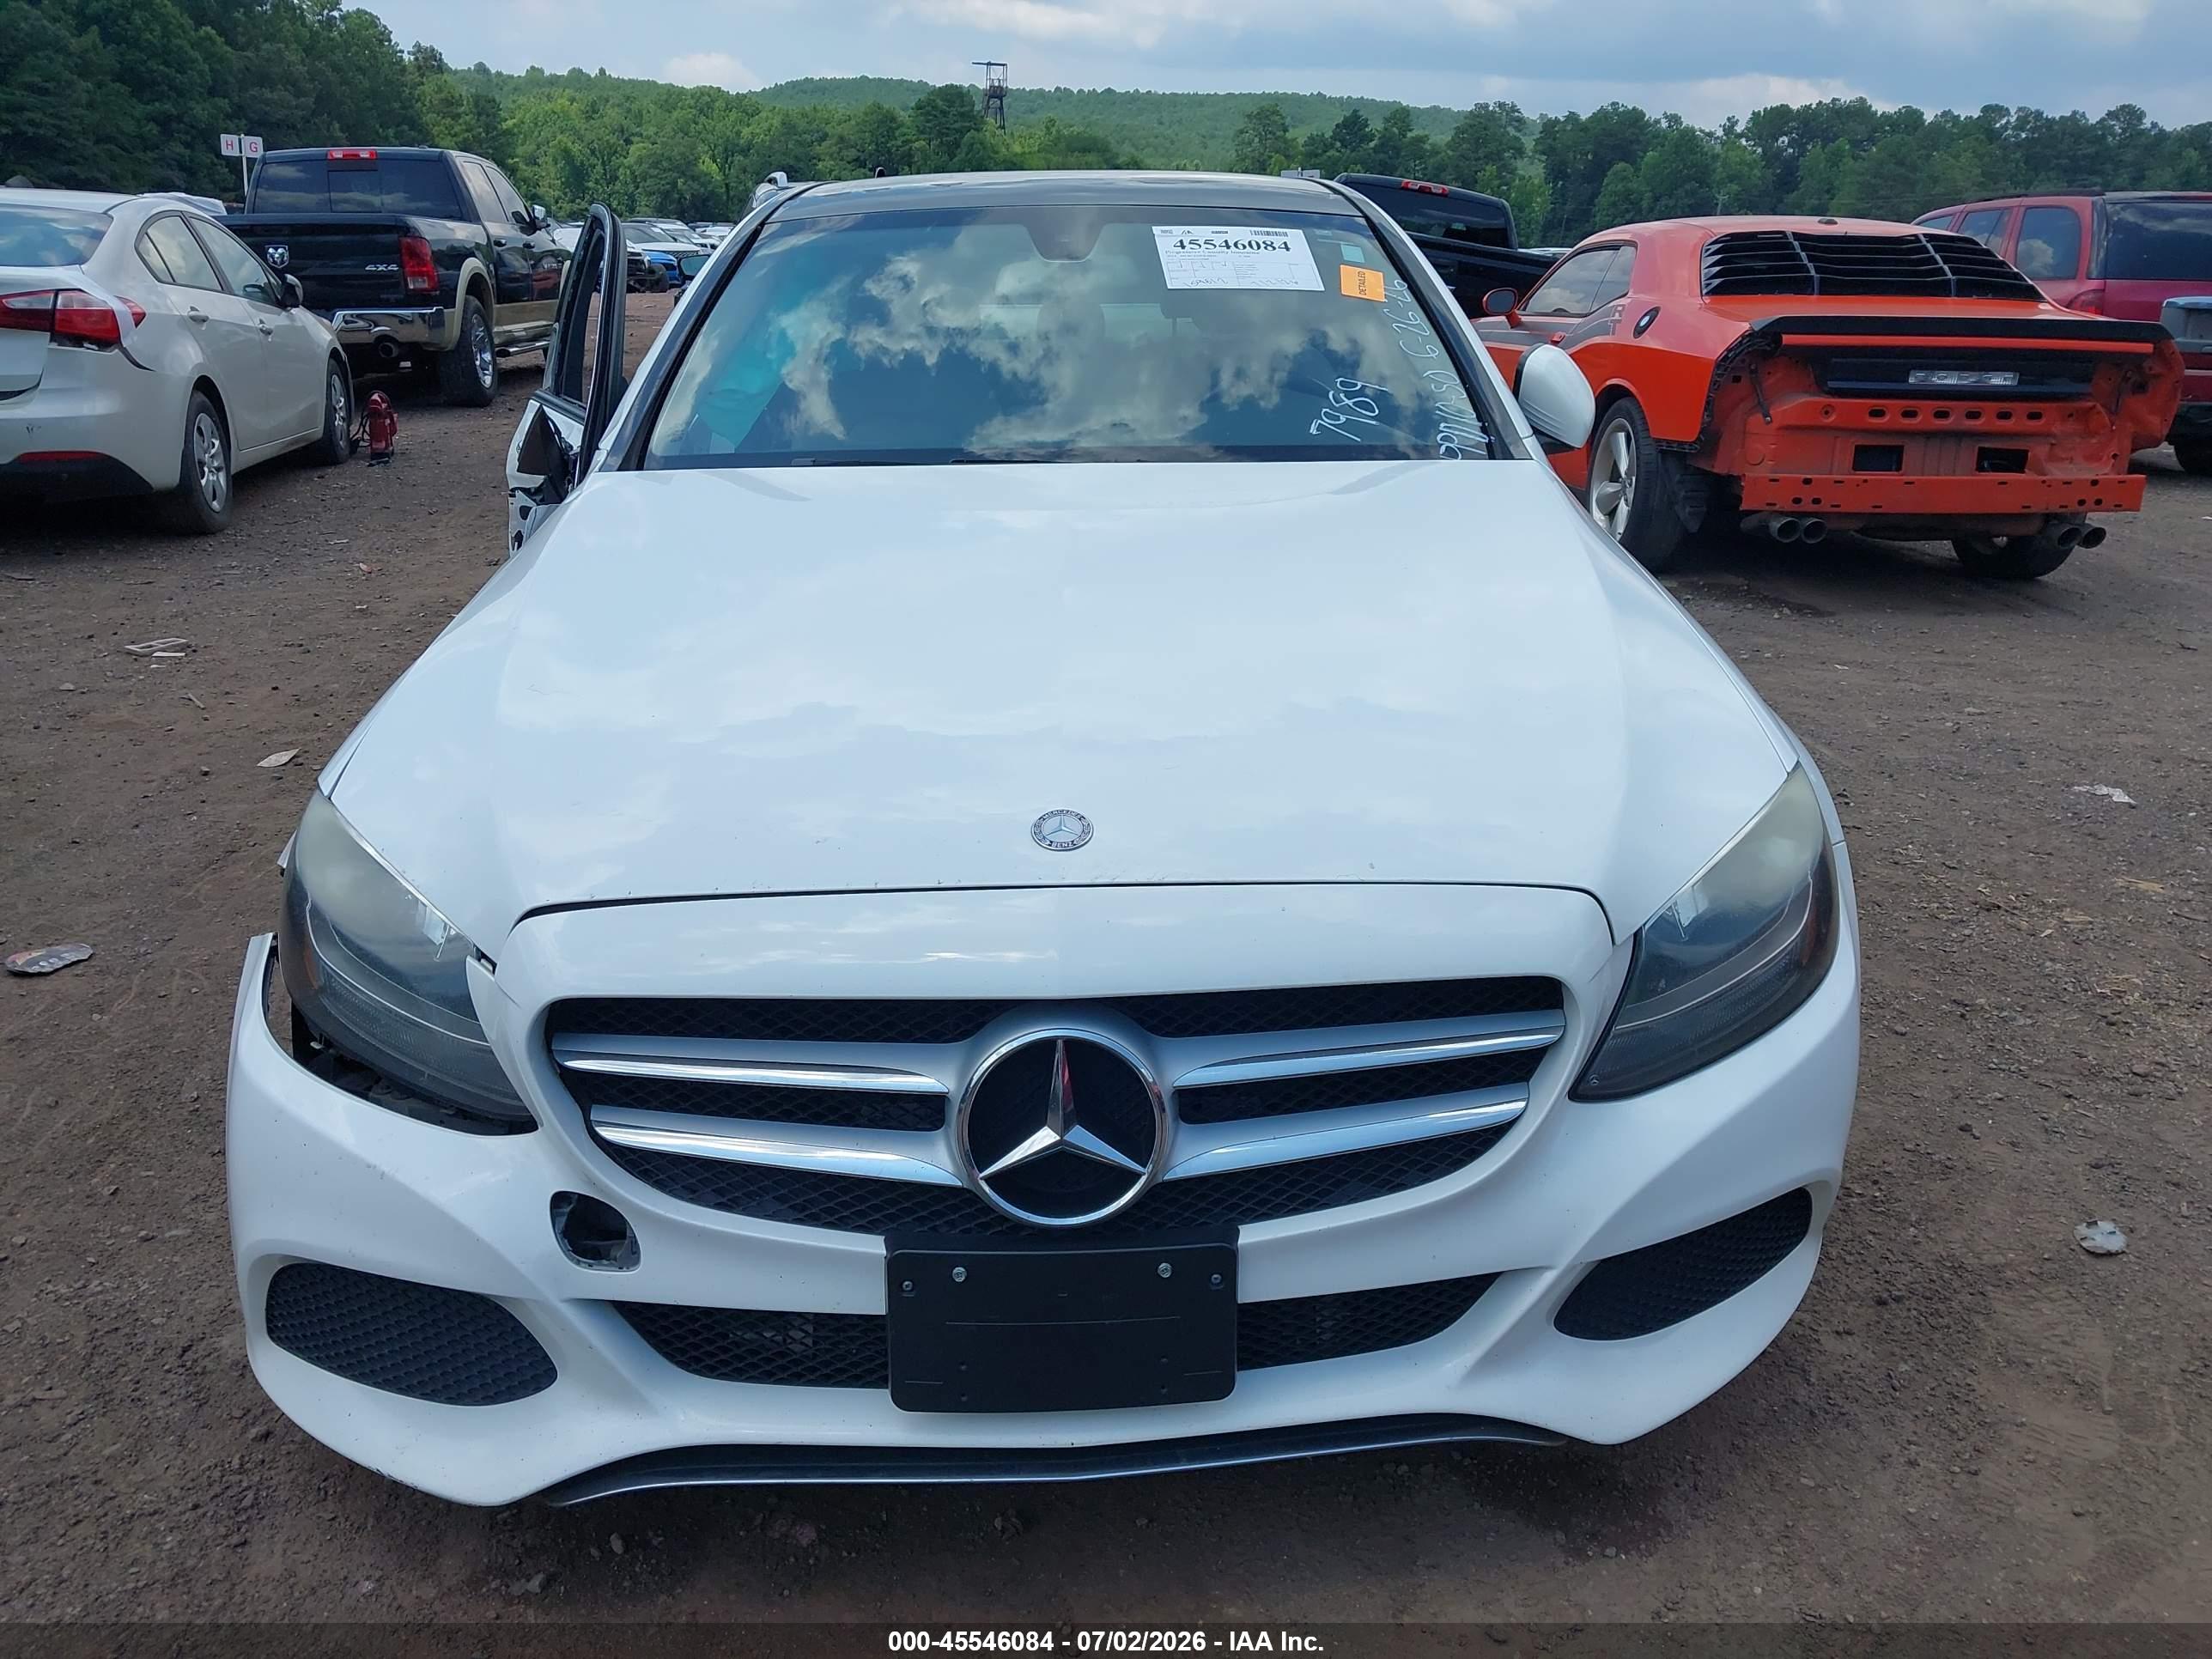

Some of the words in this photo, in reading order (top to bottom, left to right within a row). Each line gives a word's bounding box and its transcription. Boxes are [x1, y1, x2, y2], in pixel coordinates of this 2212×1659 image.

[225, 139, 234, 151] H
[249, 141, 258, 153] G
[1173, 238, 1291, 252] 45546084
[1358, 270, 1367, 295] DETAILED
[1309, 377, 1389, 443] 7989
